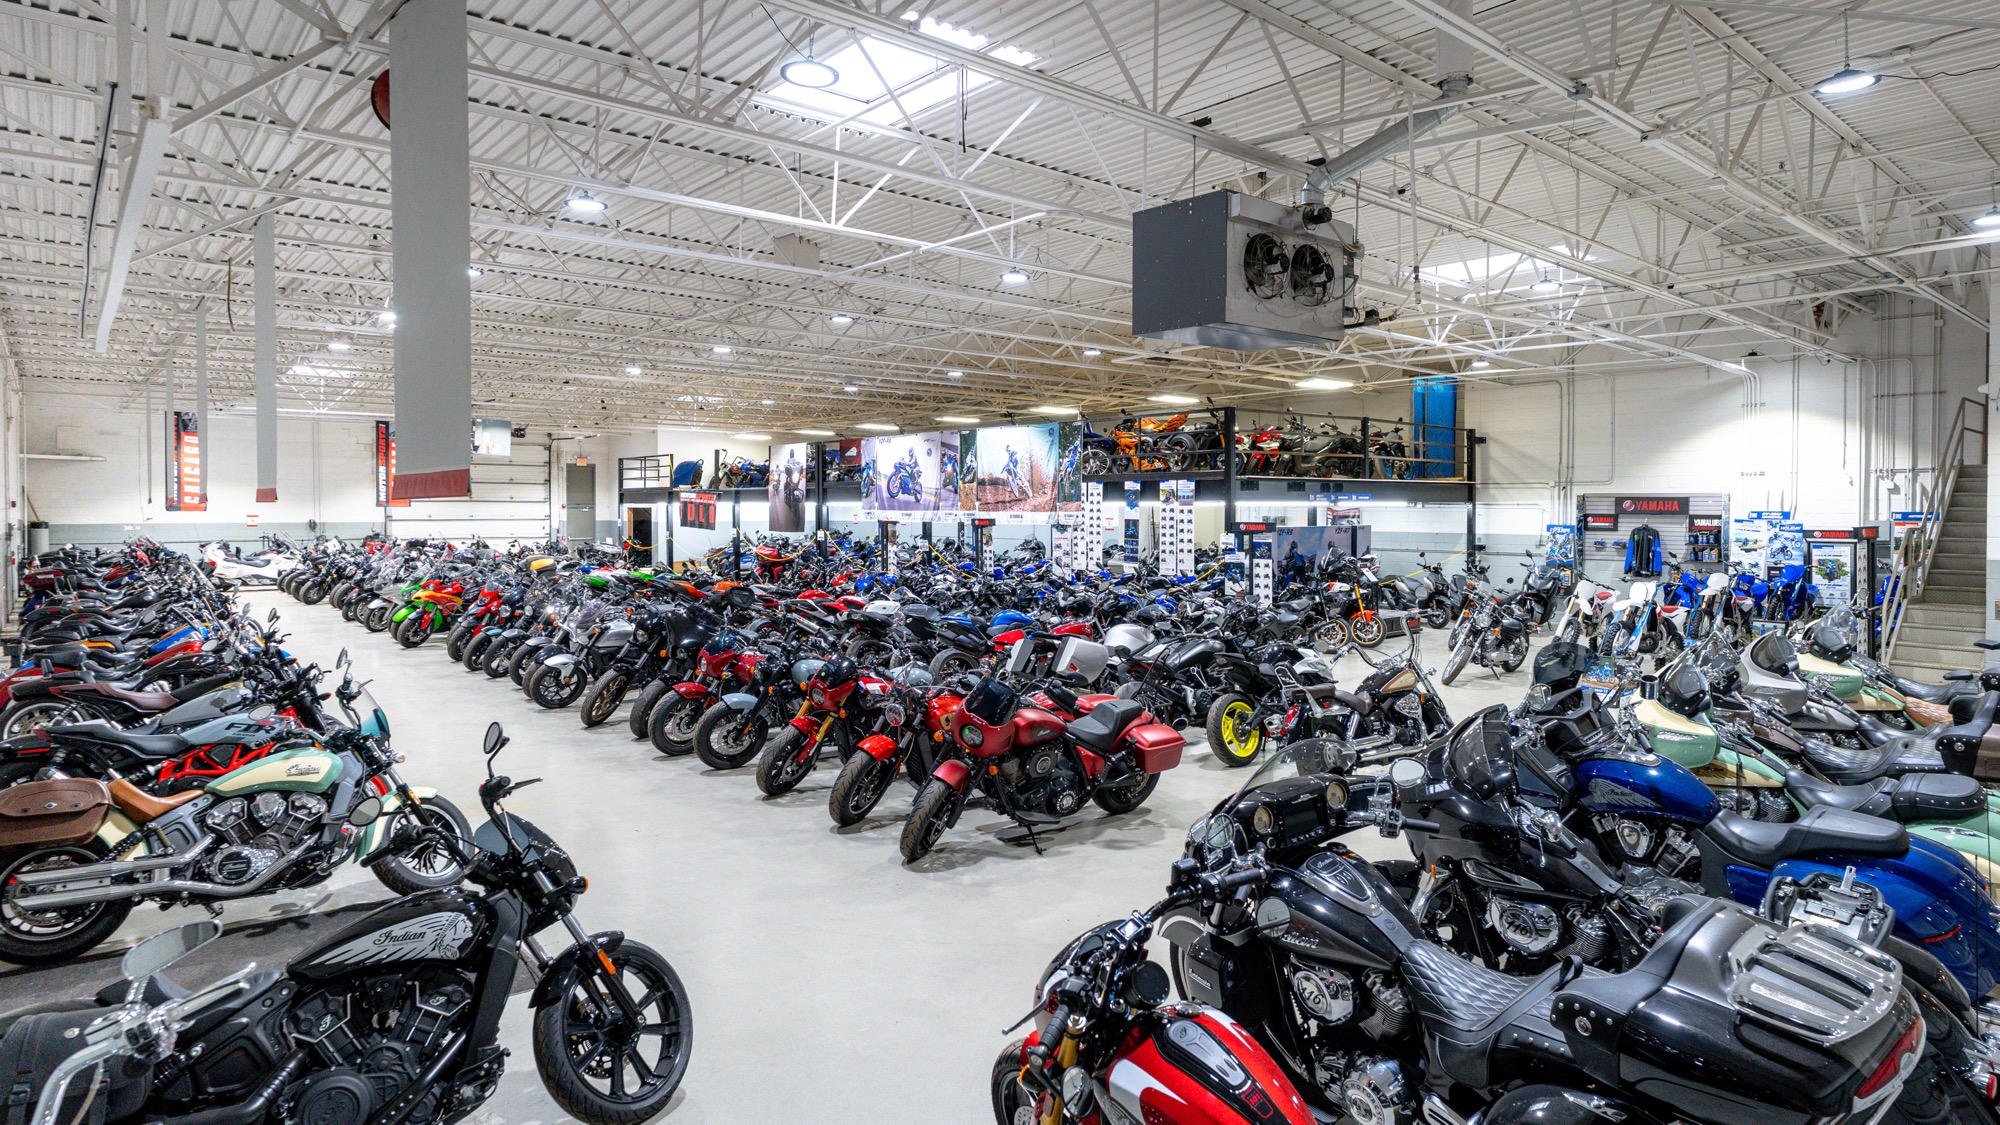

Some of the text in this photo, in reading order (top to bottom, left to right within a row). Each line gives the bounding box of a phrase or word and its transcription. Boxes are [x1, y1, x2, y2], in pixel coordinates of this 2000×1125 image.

[184, 435, 200, 505] CHICAGO
[1636, 501, 1679, 511] YAMAHA
[225, 723, 276, 734] FTR
[1506, 921, 1531, 936] 116
[373, 929, 427, 946] Indian
[1301, 985, 1324, 1005] 116
